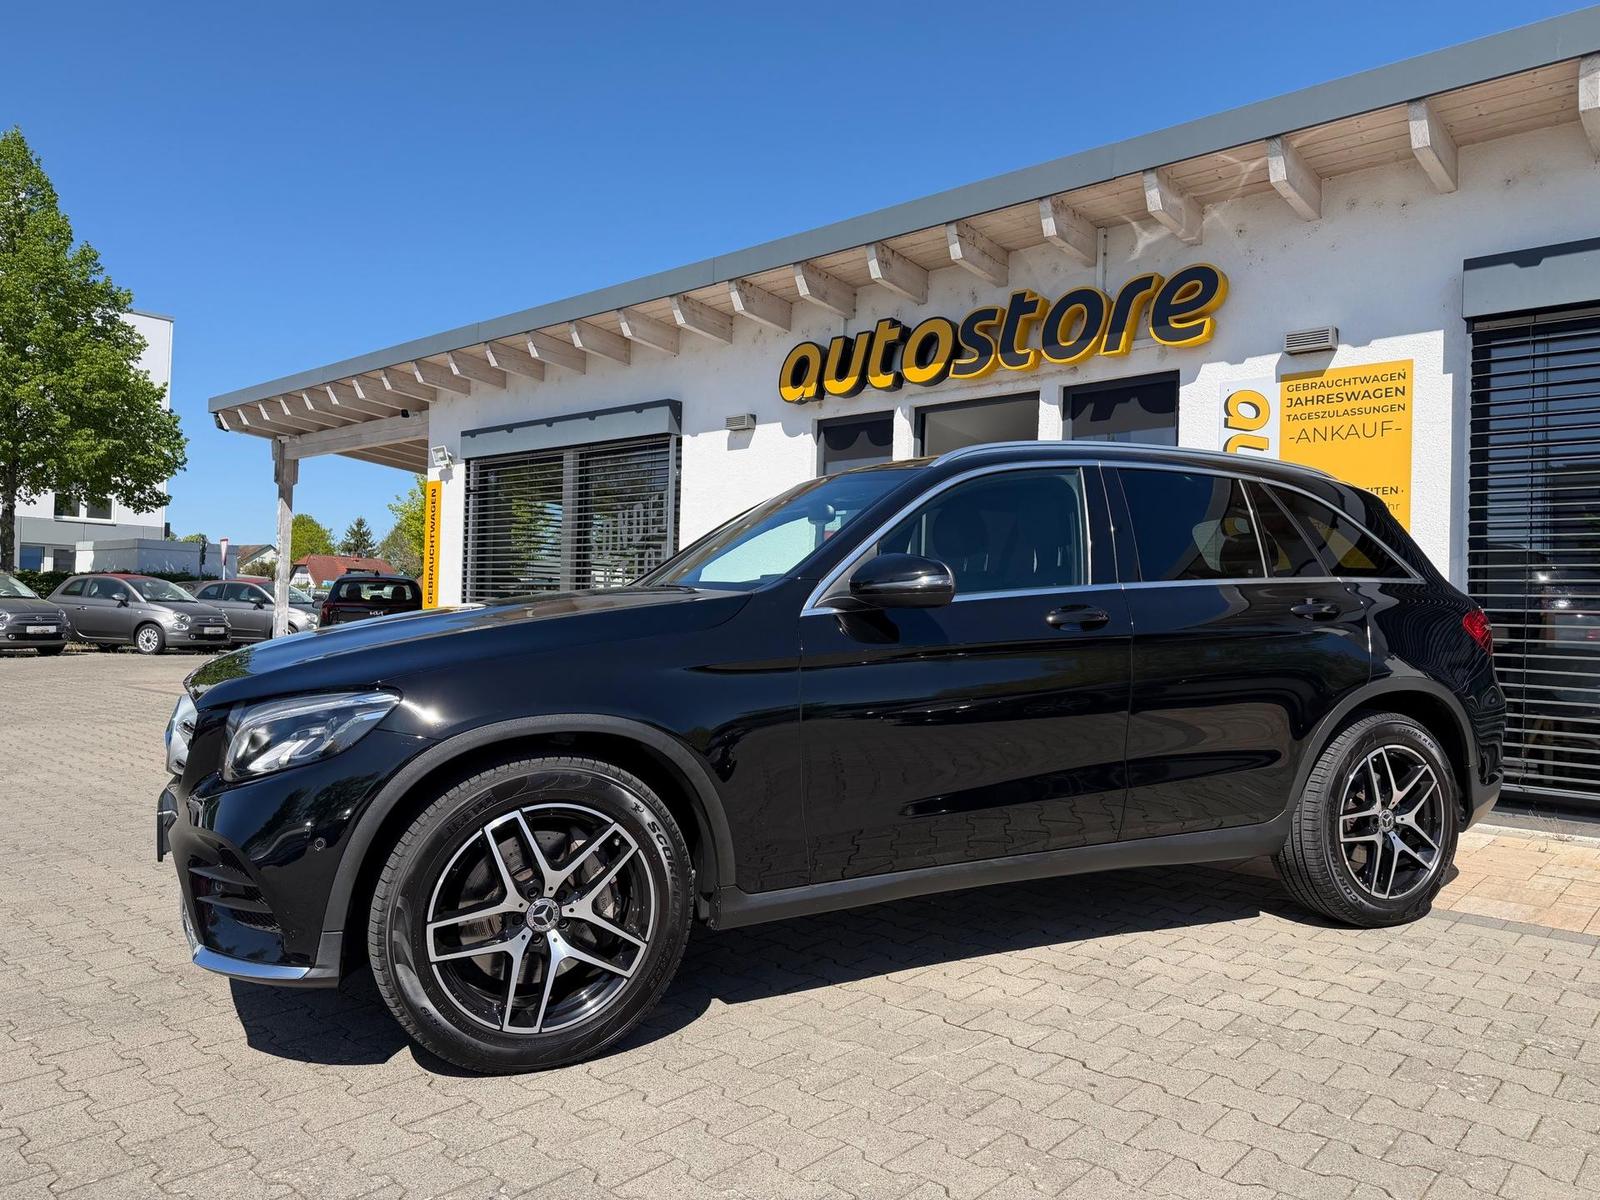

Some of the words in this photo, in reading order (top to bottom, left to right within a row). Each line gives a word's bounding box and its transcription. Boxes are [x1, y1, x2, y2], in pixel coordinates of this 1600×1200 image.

[779, 263, 1229, 404] autostore
[1286, 371, 1406, 393] GEBRAUCHTWAGEN
[1286, 385, 1406, 408] JAHRESWAGEN
[1286, 403, 1406, 422] TAGESZULASSUNGEN
[427, 488, 437, 604] GEBRAUCHTWAGEN
